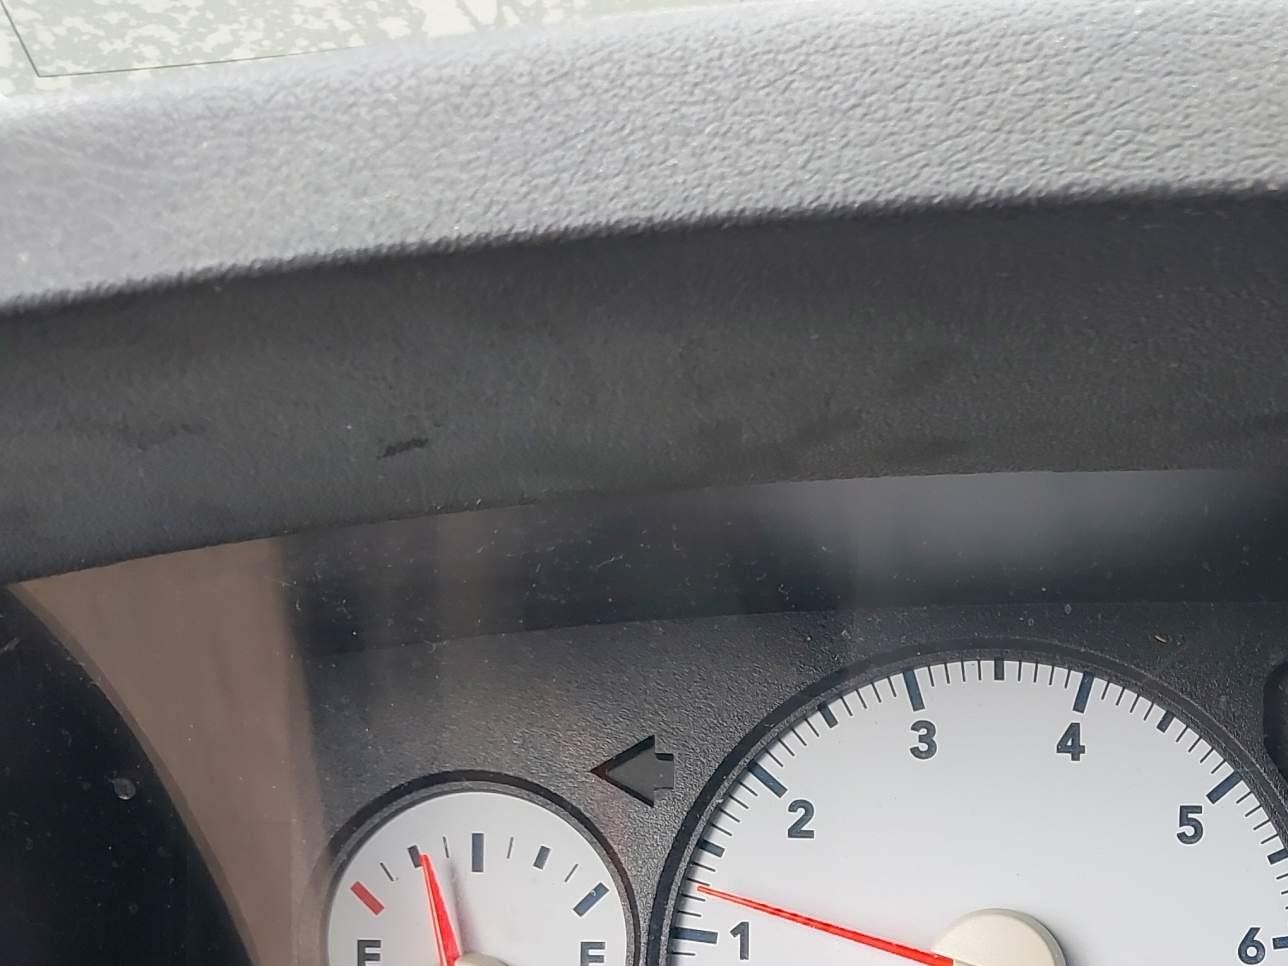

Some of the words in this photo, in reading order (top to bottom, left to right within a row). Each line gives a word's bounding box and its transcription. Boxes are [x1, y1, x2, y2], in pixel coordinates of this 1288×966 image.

[910, 720, 937, 759] 3
[1056, 723, 1085, 761] 4
[788, 800, 814, 838] 2
[1177, 805, 1203, 844] 5
[730, 922, 749, 960] 1
[1238, 927, 1265, 965] 6
